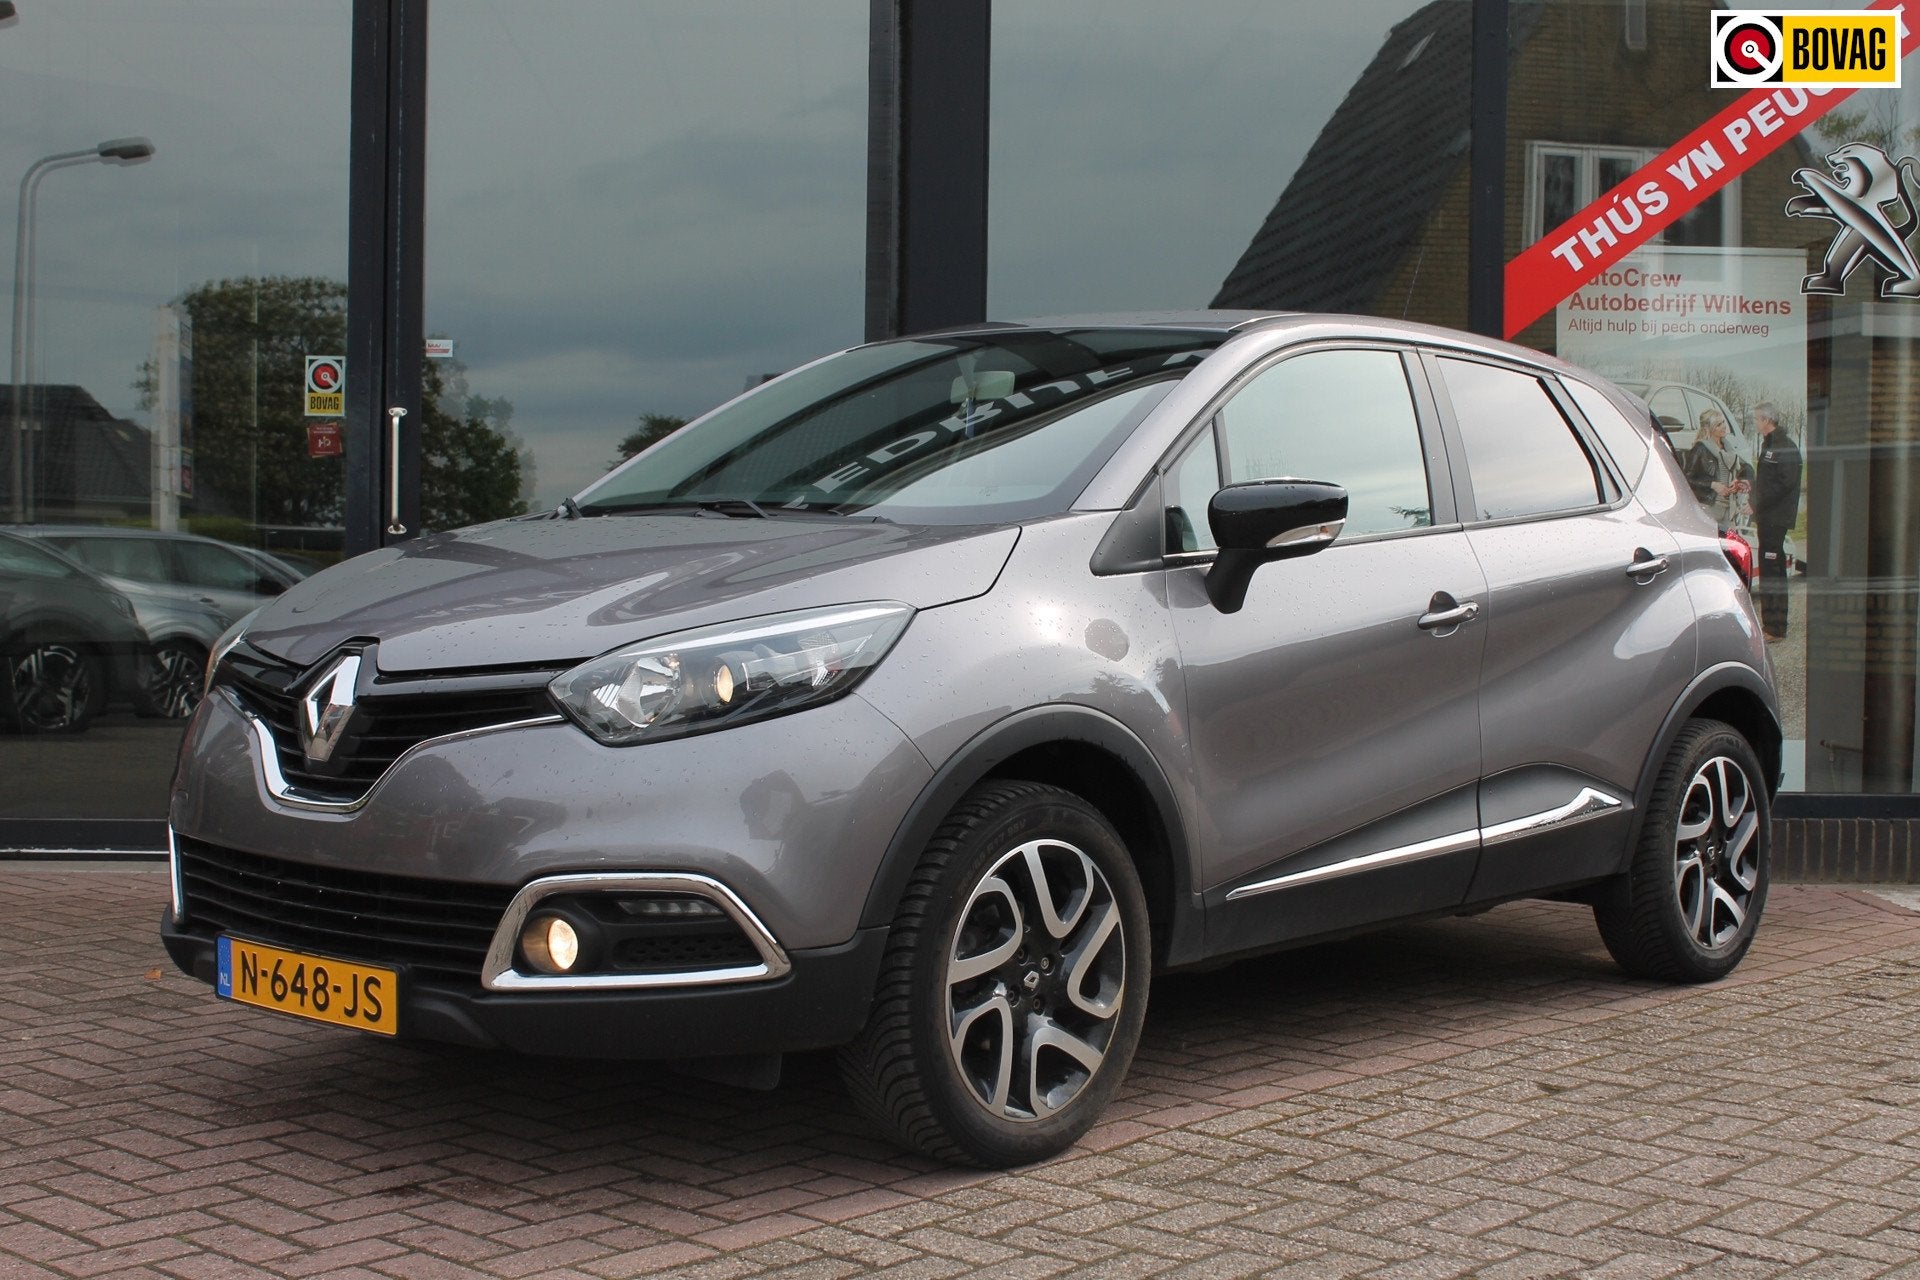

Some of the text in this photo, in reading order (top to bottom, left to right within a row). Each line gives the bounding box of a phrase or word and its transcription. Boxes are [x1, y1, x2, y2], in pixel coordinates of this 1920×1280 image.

[1550, 181, 1669, 272] THÚS
[1665, 139, 1726, 192] YN
[1586, 268, 1682, 287] utoCrew
[1568, 292, 1792, 317] Autobedrijf Wilkens
[1568, 319, 1769, 338] Altijd hulp bij pech onderweg
[310, 396, 340, 411] BOVAG
[219, 972, 231, 988] NL
[241, 950, 383, 1023] N-648-JS
